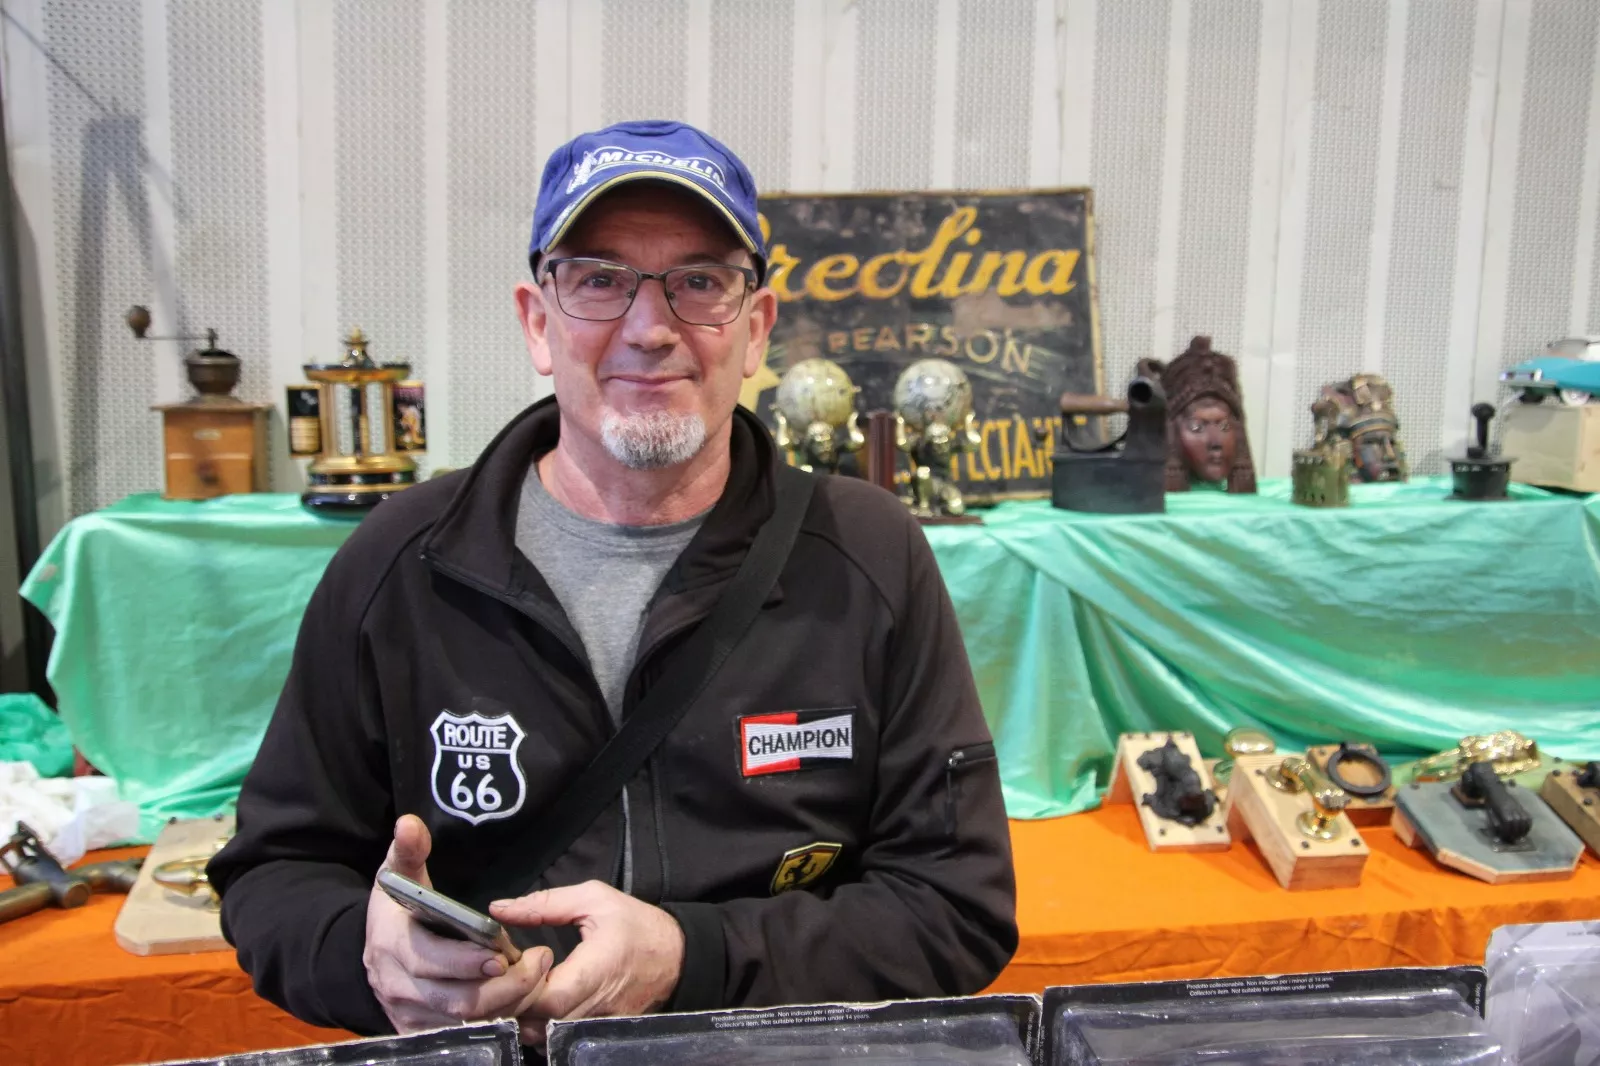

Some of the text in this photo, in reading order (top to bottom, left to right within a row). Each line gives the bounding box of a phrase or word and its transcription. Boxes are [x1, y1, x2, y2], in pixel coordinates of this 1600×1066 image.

[598, 150, 724, 186] MICHELIN
[757, 205, 1081, 303] reolina
[827, 321, 1033, 374] PEARSON
[443, 723, 508, 749] ROUTE
[748, 727, 850, 756] CHAMPION
[457, 754, 491, 770] US
[450, 771, 502, 811] 66
